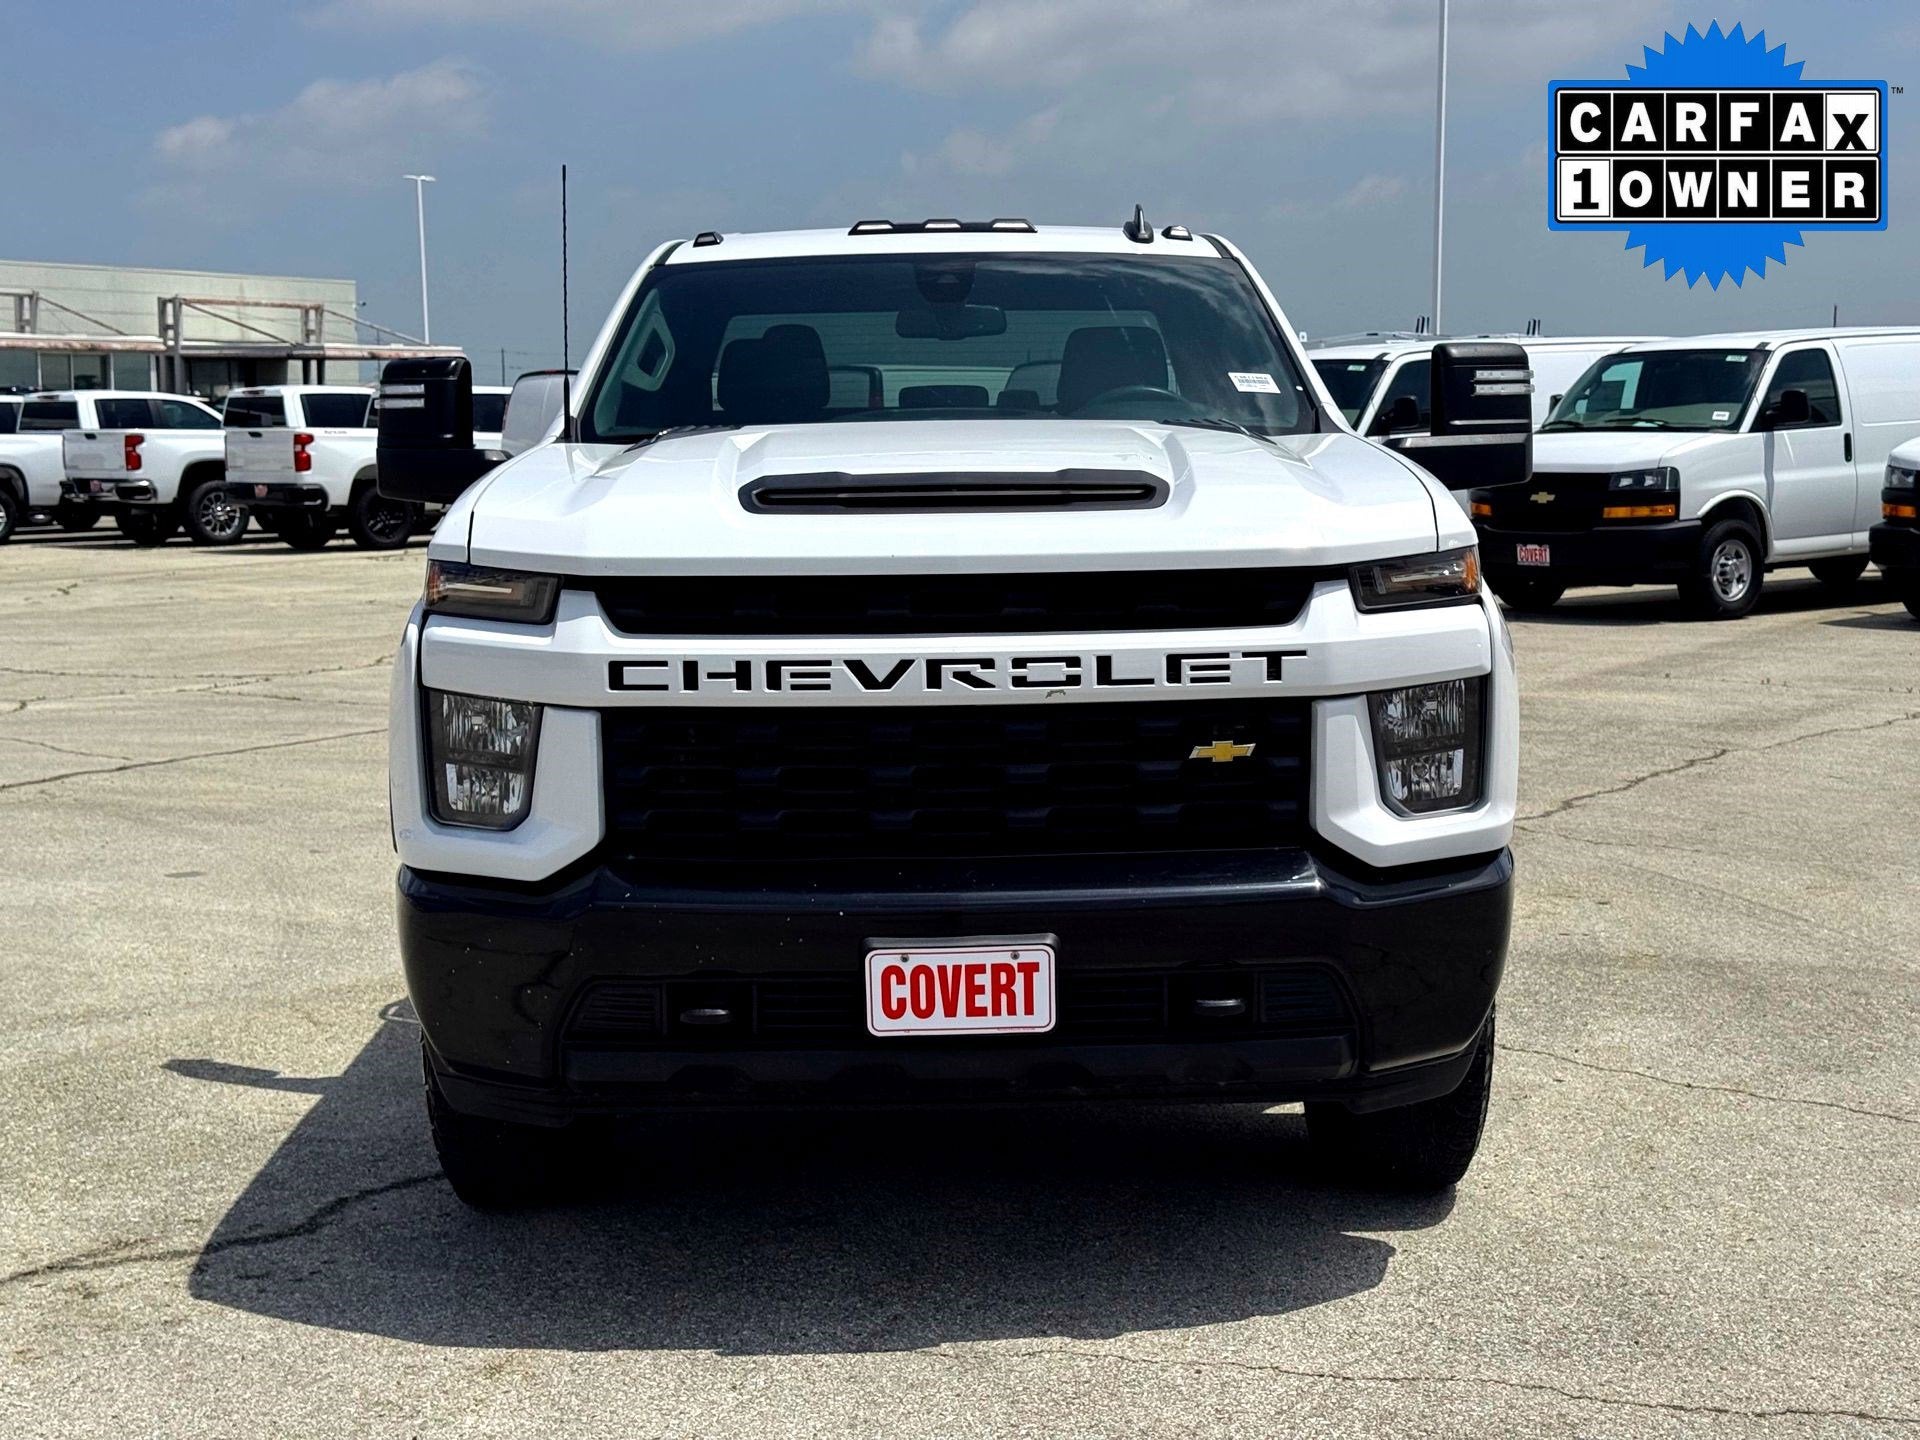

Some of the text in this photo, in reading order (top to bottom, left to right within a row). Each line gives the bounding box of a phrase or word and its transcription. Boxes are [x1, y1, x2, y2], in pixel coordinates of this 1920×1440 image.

[1519, 547, 1548, 562] COVERT
[606, 650, 1308, 693] CHEVROLET
[880, 961, 1041, 1020] COVERT
